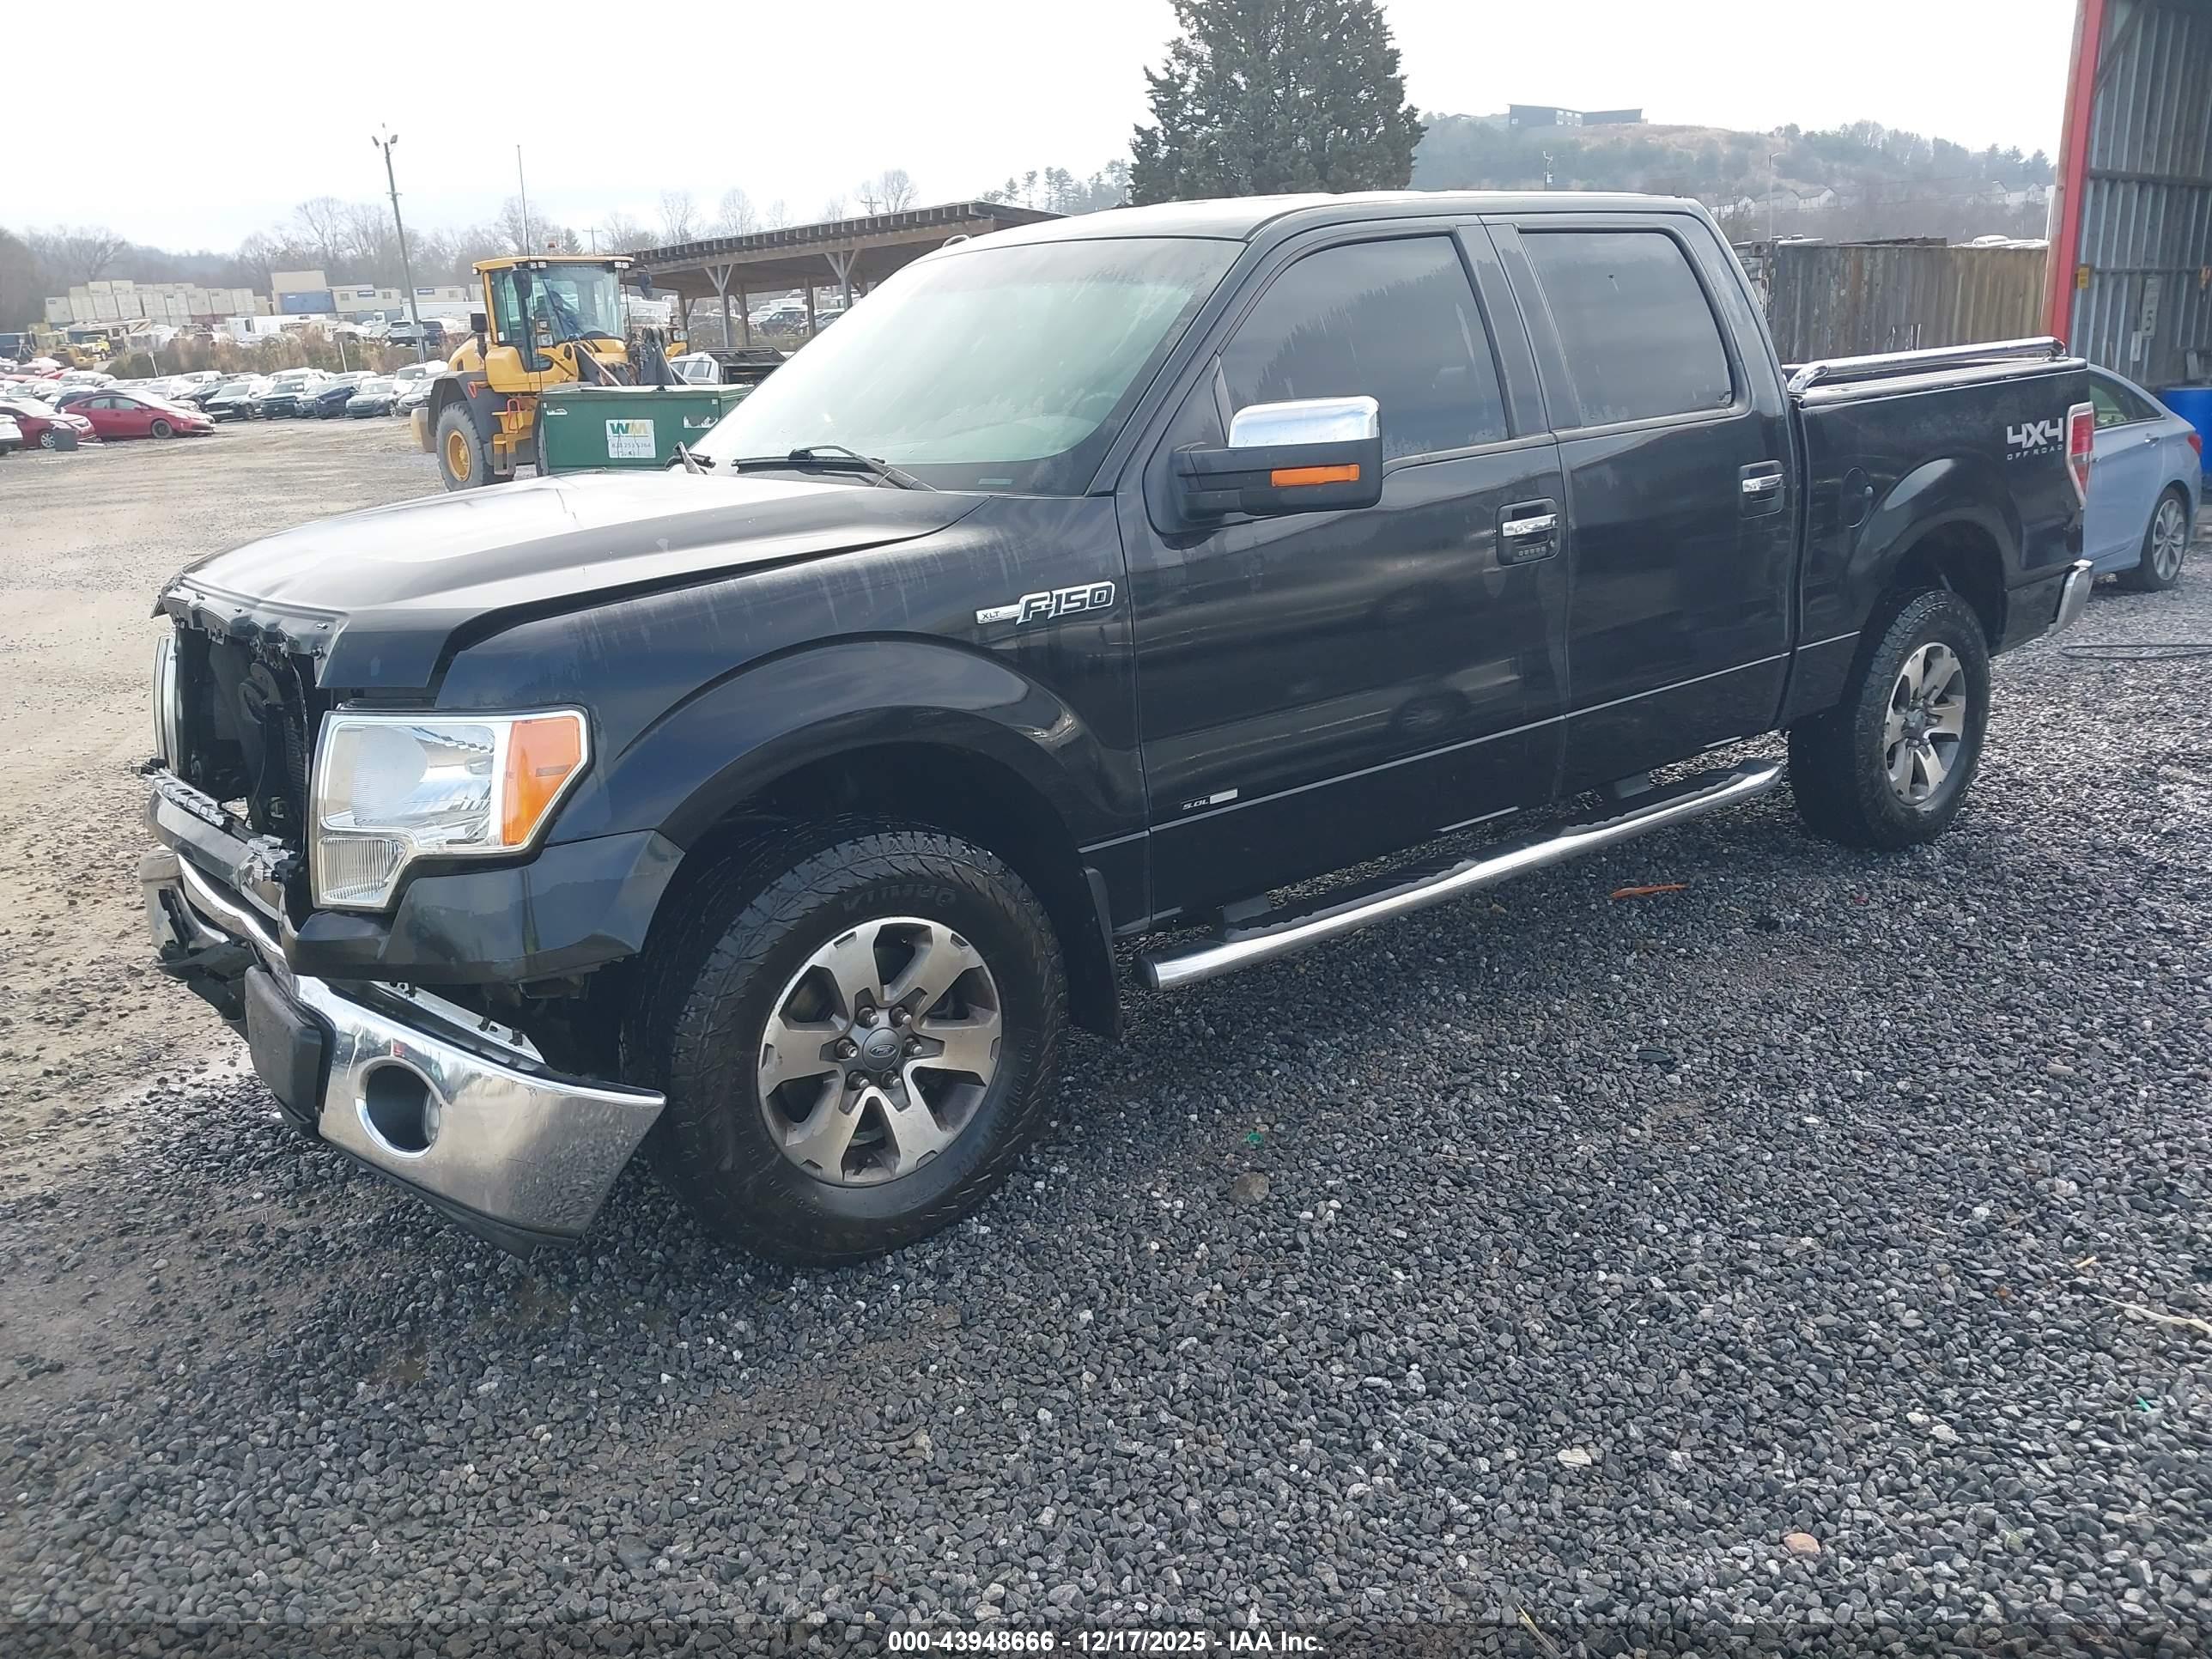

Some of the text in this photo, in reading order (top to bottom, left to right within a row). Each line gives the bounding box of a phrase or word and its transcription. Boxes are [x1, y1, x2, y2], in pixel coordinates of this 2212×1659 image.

[609, 422, 647, 434] WM
[2007, 444, 2063, 460] OFF ROAD
[981, 611, 1000, 620] XLT
[1182, 799, 1209, 811] 5.0L
